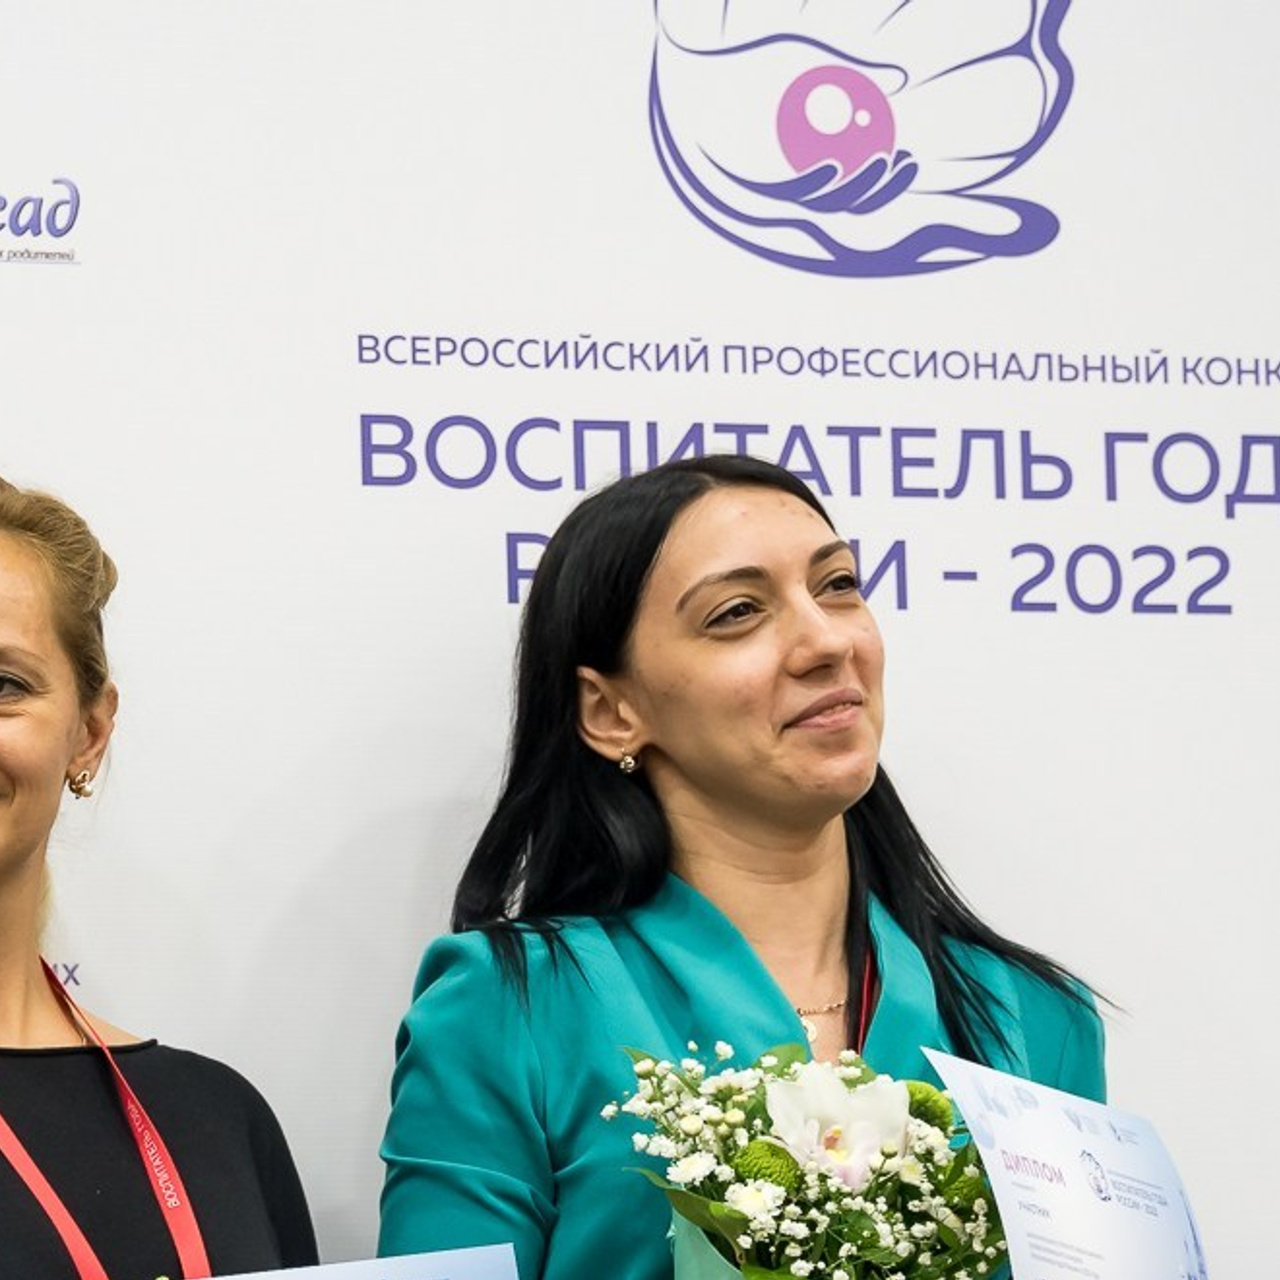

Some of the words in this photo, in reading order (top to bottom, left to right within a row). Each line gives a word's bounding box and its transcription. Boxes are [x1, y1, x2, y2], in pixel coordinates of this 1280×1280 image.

[357, 334, 710, 373] ВСЕРОССИЙСКИЙ
[723, 345, 1169, 384] ПРОФЕССИОНАЛЬНЫЙ
[1009, 543, 1234, 616] 2022
